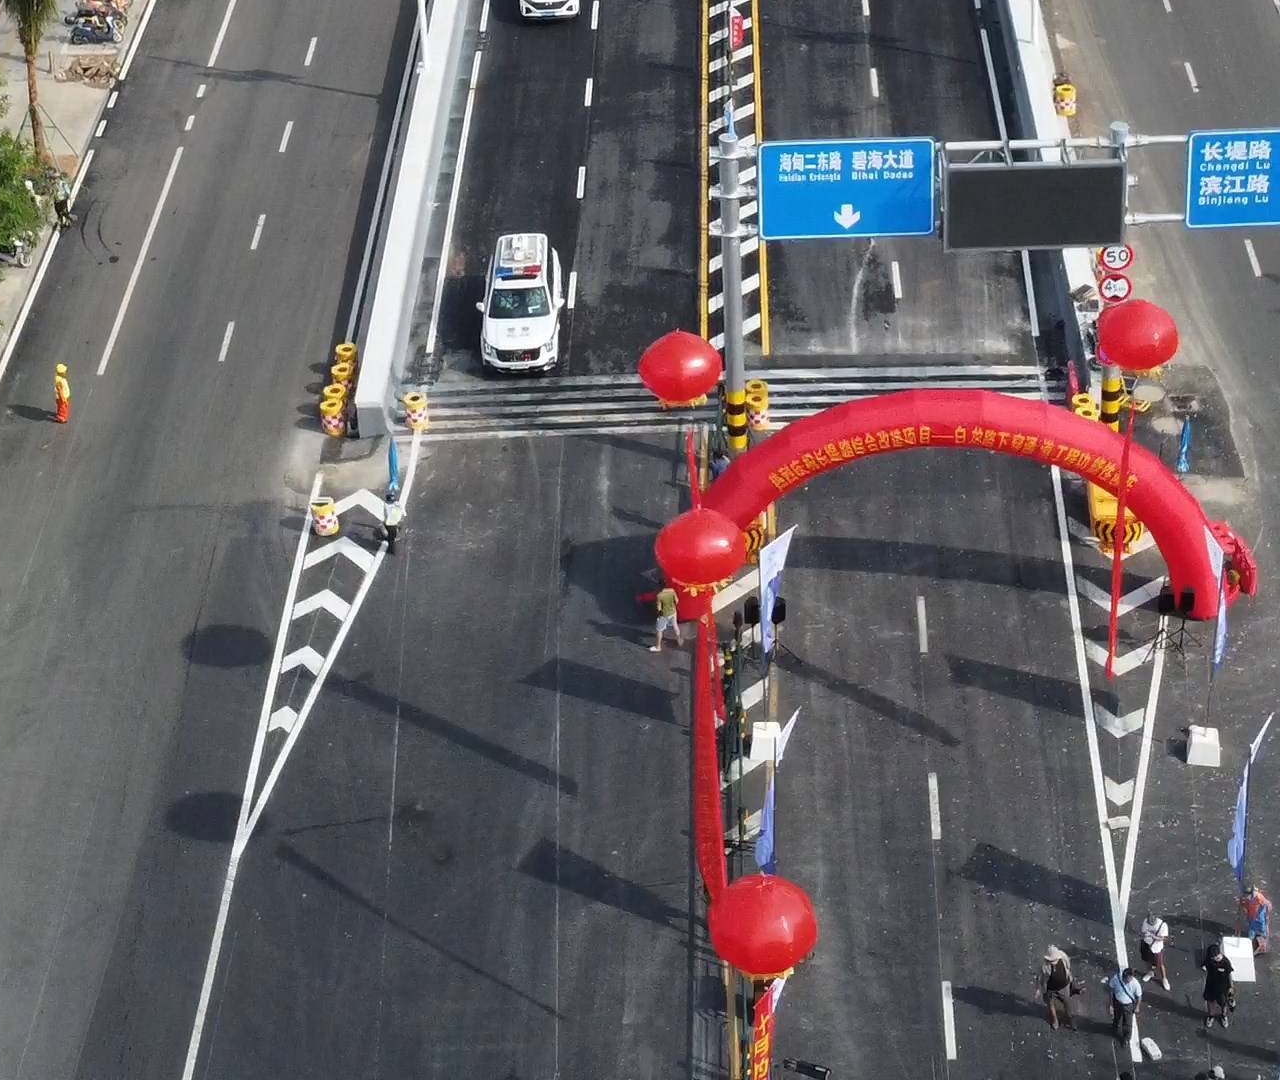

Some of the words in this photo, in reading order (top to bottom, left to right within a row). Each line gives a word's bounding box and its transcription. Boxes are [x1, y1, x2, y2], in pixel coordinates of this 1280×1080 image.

[1200, 140, 1272, 160] 长堤路
[779, 151, 841, 172] 海甸二东路
[852, 149, 914, 170] 碧海大道
[1200, 162, 1249, 172] Changdi
[1256, 162, 1270, 170] Lu
[1199, 174, 1269, 194] 滨江路
[1199, 195, 1249, 206] Binjiang
[1255, 195, 1269, 204] Lu
[1106, 250, 1129, 263] 50
